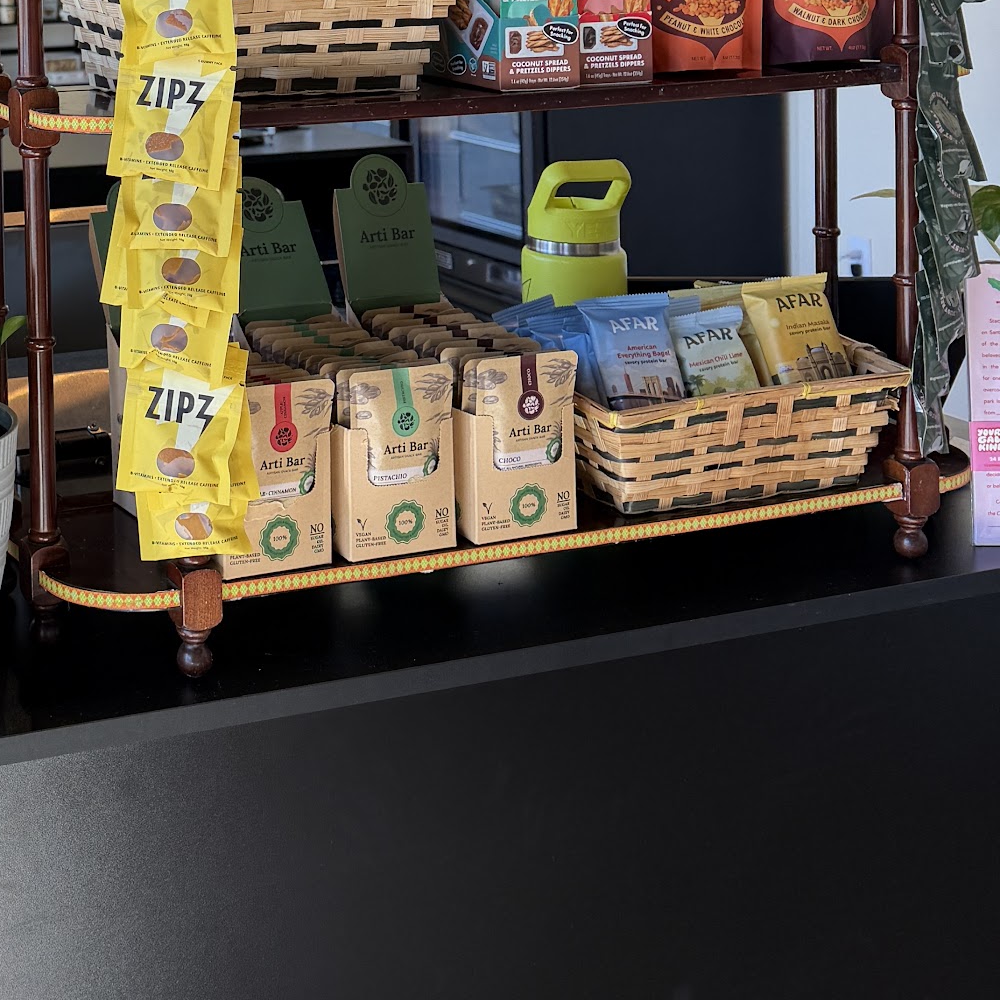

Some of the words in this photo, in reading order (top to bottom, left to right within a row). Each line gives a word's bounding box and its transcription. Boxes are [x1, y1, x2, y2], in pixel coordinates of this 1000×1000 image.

[793, 6, 820, 24] WALNUT
[827, 16, 847, 26] DARK
[663, 15, 691, 33] PEANUT
[700, 26, 720, 35] WHITE
[512, 60, 544, 68] COCONUT
[545, 59, 568, 67] SPREAD
[516, 67, 545, 75] PRETZELS
[136, 74, 206, 122] ZIPZ
[360, 228, 388, 244] Arti
[392, 228, 415, 241] Bar
[240, 242, 269, 257] Arti
[271, 242, 297, 255] Bar
[776, 292, 823, 312] AFAR
[609, 316, 658, 333] AFAR
[786, 323, 805, 331] Indian
[807, 319, 829, 328] Masala
[805, 327, 822, 335] protein
[683, 327, 733, 349] AFAR
[617, 351, 651, 360] Everything
[653, 350, 670, 358] Bagel
[689, 358, 714, 368] Mexican
[715, 355, 728, 364] Chili
[729, 352, 742, 360] Lime
[145, 386, 215, 438] ZIPZ
[509, 425, 531, 438] Arti
[534, 424, 552, 434] Bar
[383, 443, 406, 455] Arti
[409, 441, 429, 451] Bar
[260, 458, 283, 471] Arti
[286, 457, 306, 467] Bar
[498, 456, 521, 464] CHOCO
[373, 473, 407, 481] PISTACHIO
[557, 491, 570, 500] NO
[435, 508, 449, 517] NO
[310, 523, 324, 533] NO
[399, 518, 413, 526] 100%
